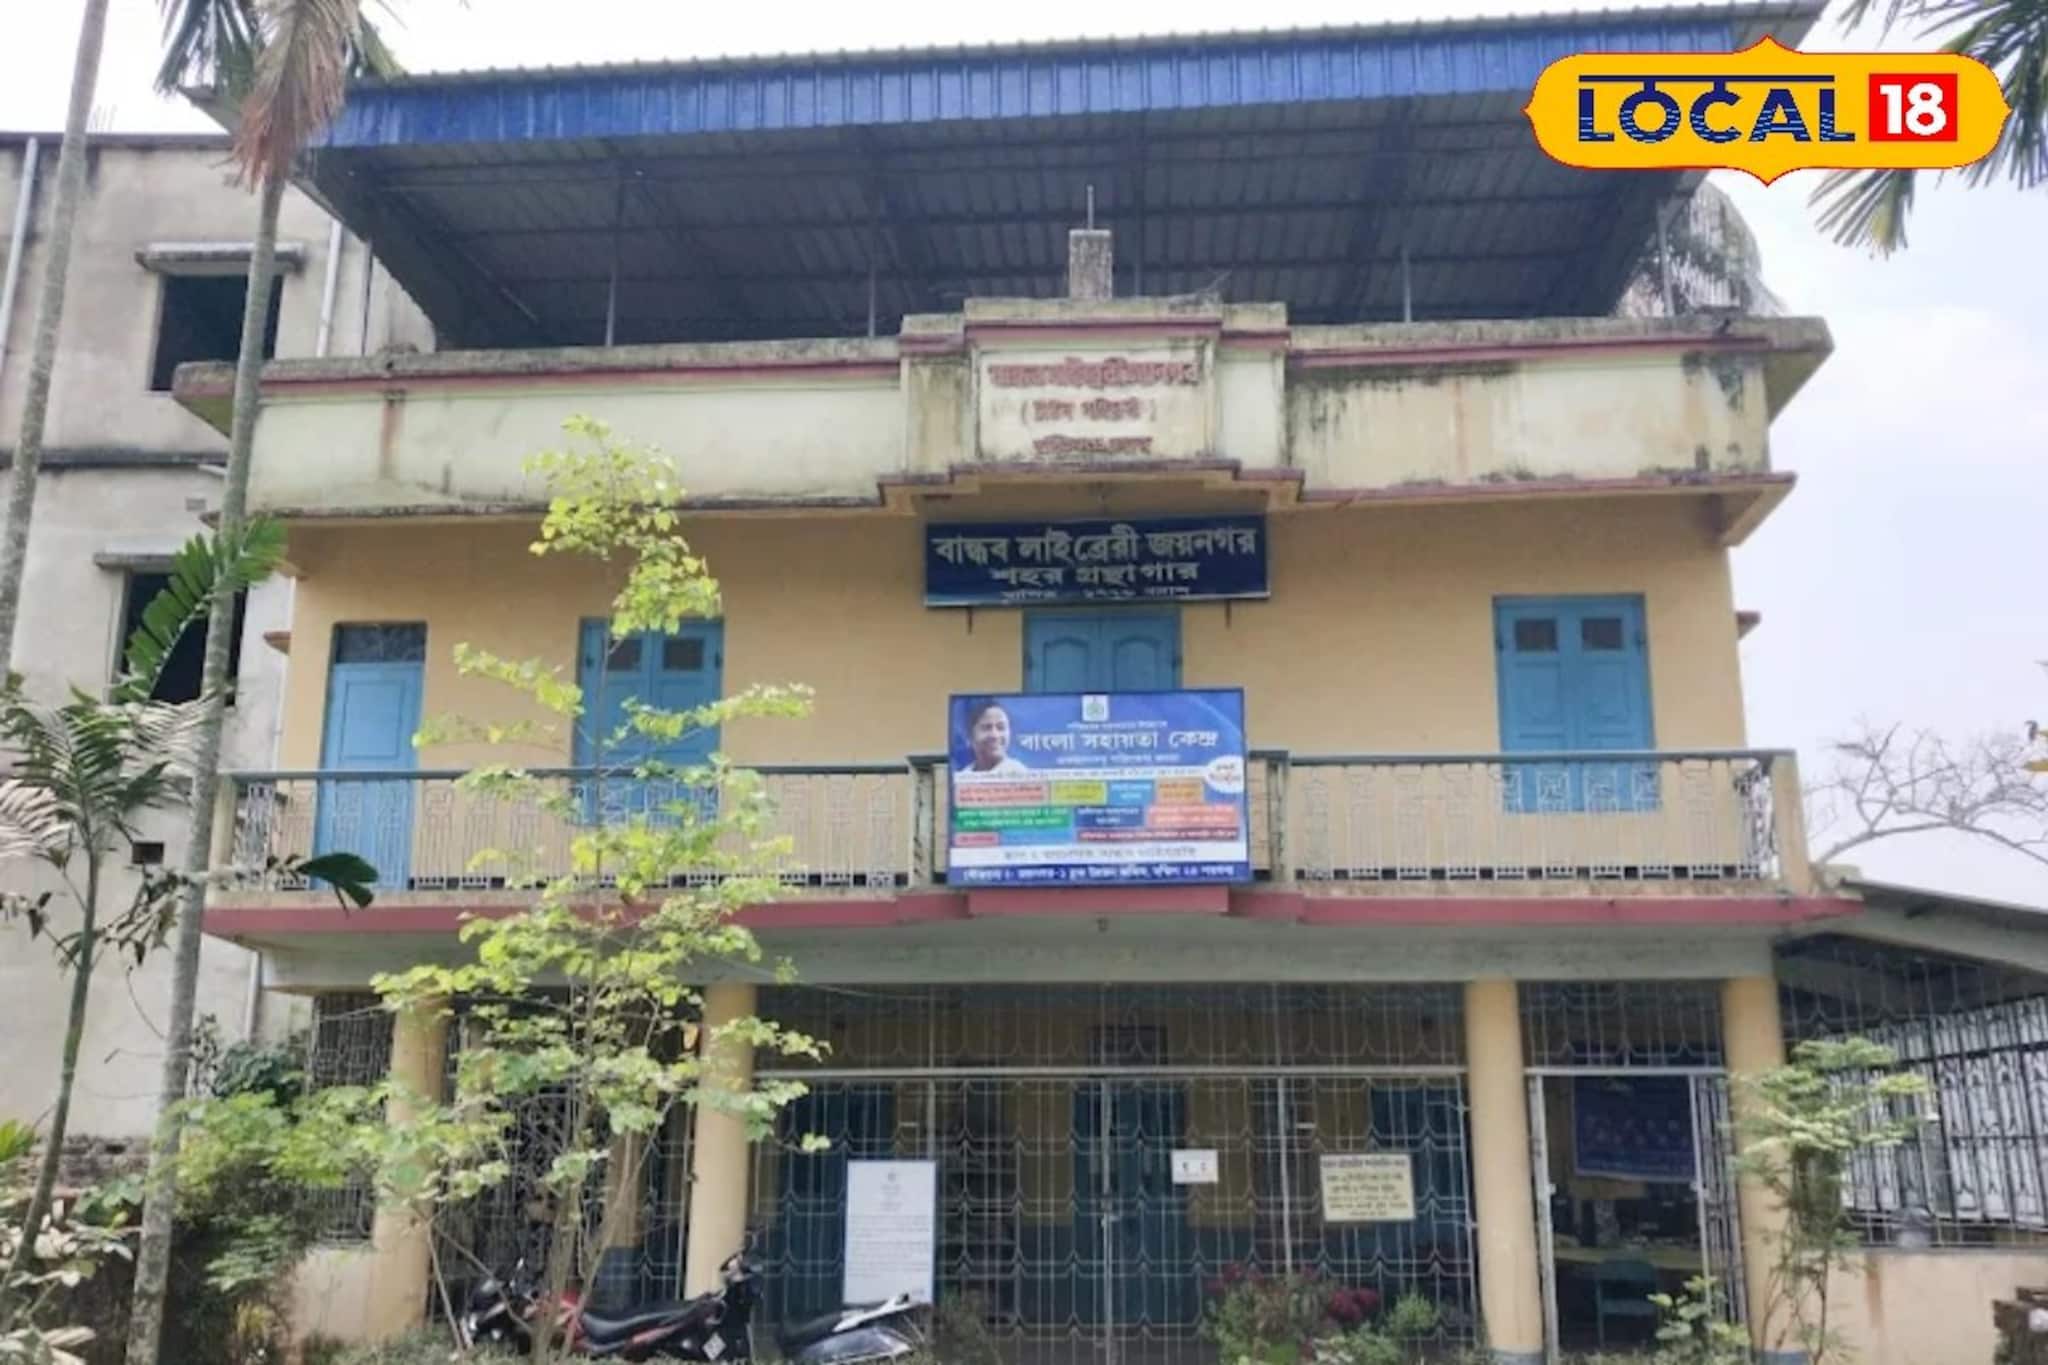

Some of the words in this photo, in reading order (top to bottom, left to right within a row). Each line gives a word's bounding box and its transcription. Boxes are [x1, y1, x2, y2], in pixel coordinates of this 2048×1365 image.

[932, 534, 1009, 566] বান্ধব
[1145, 527, 1258, 558] জয়নগর
[990, 565, 1064, 587] শহর
[1019, 730, 1075, 752] বাংলা
[1082, 729, 1159, 752] সহায়তা
